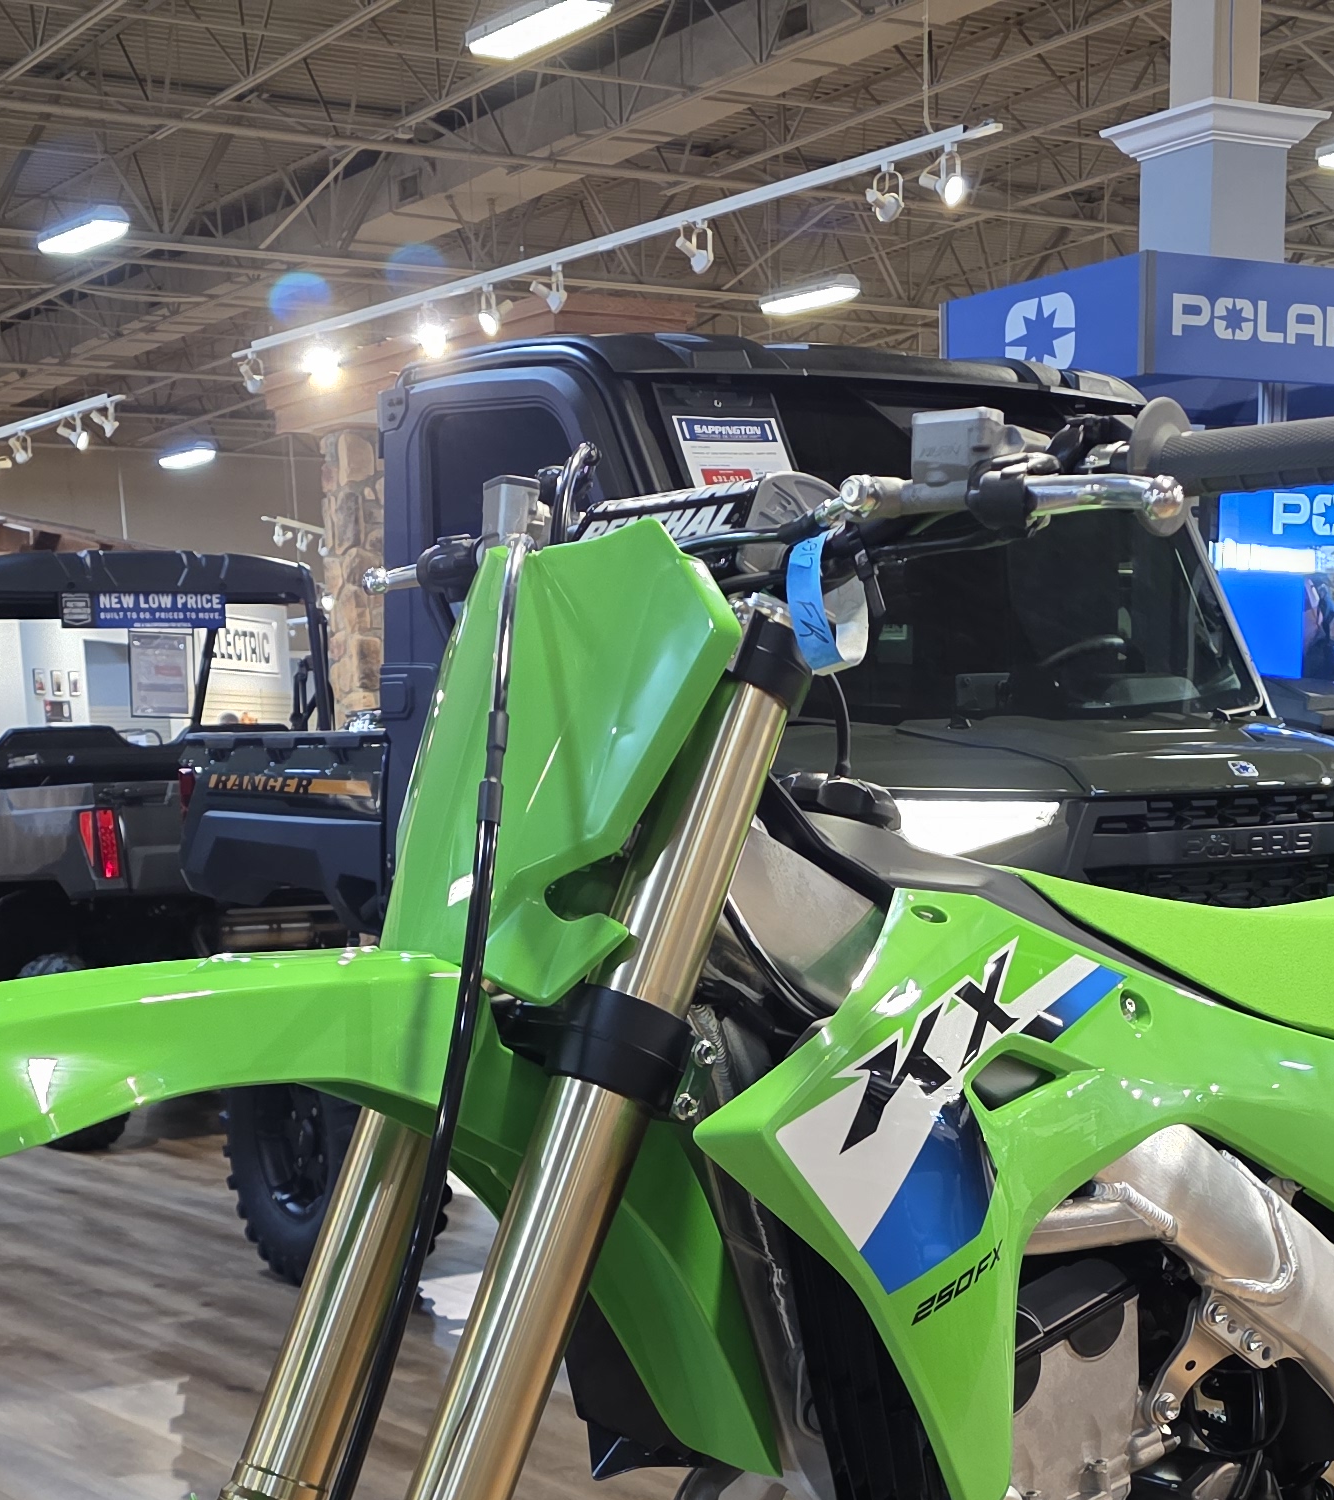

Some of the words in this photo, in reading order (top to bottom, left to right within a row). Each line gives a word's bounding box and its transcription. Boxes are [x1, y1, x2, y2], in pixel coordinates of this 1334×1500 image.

[693, 424, 762, 435] SAPPINGTON
[99, 593, 135, 609] NEW
[139, 593, 174, 608] LOW
[177, 593, 222, 608] PRICE
[100, 611, 125, 619] BUILT
[127, 611, 137, 619] TO
[155, 611, 184, 619] PRICED
[186, 611, 196, 619] TO
[198, 611, 222, 619] MOVE.
[212, 628, 271, 664] LECTRIC
[208, 773, 313, 795] RANGER
[911, 1238, 1003, 1327] 250FX
